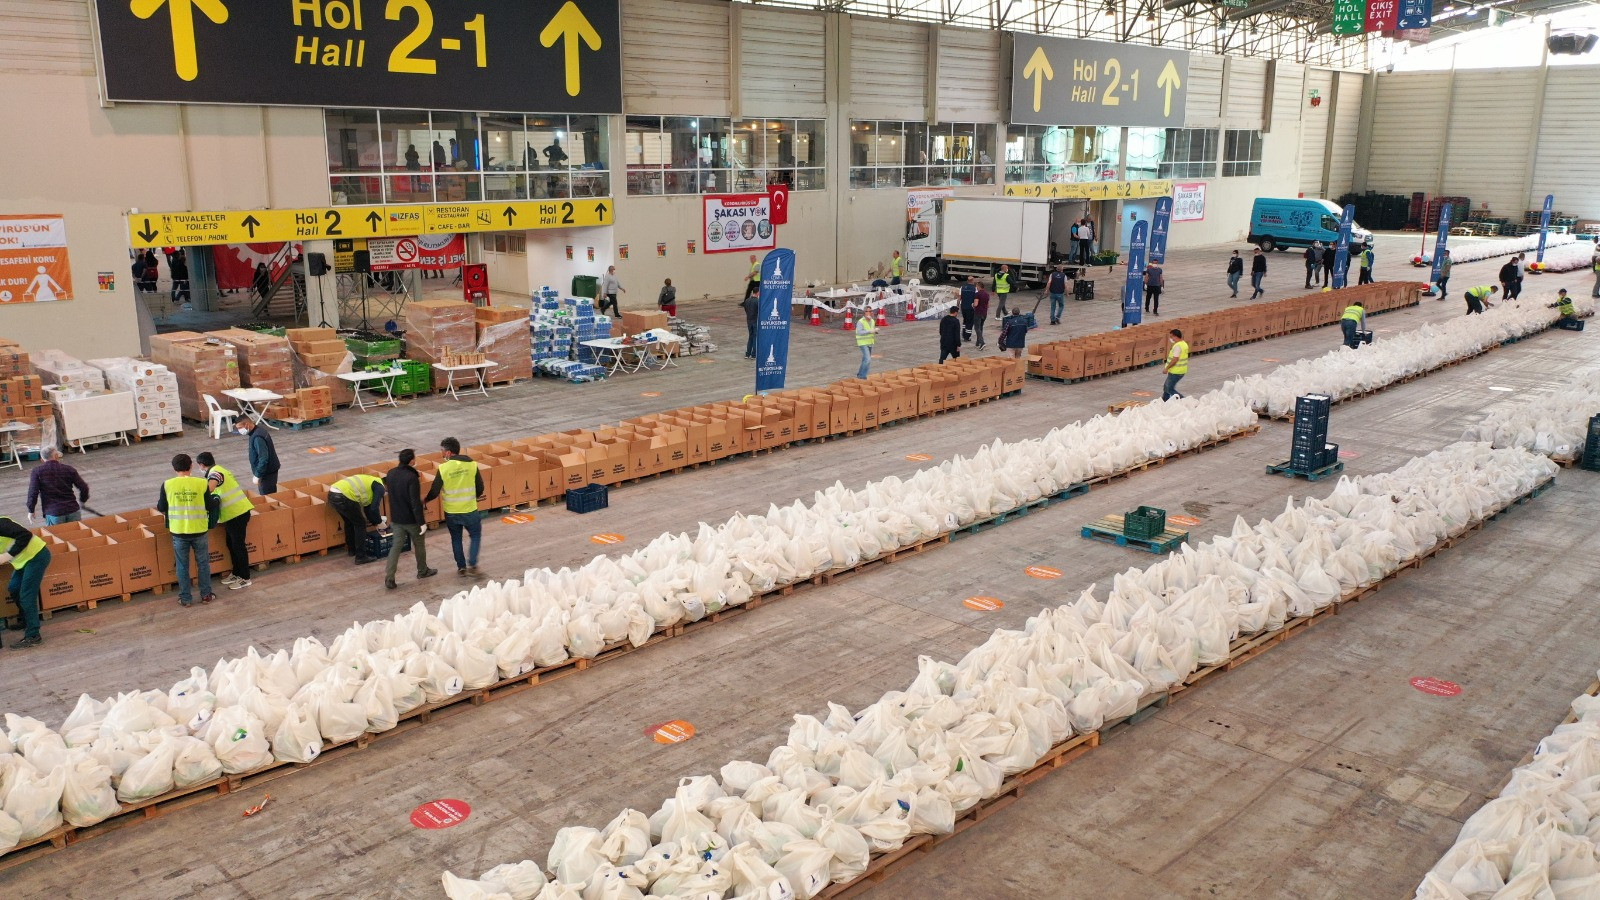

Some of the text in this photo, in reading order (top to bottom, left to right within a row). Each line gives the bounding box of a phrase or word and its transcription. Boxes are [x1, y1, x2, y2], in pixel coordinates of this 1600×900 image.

[1339, 4, 1358, 13] HOL
[1370, 2, 1393, 12] ÇIKIŞ
[1335, 13, 1363, 22] HALL
[1370, 10, 1392, 20] EXIT
[292, 0, 487, 75] Hol 2-1
[294, 36, 366, 68] Hall
[1073, 58, 1139, 106] Hol 2-1
[1071, 86, 1096, 103] Hall
[1125, 182, 1131, 196] 2
[540, 202, 574, 224] Hol 2
[714, 208, 746, 220] ŞAKASI
[296, 210, 342, 235] Hol 2
[540, 216, 557, 225] Hall
[0, 224, 50, 233] İRÜS'ÜN
[296, 226, 318, 236] Hall
[33, 256, 57, 264] KORU.
